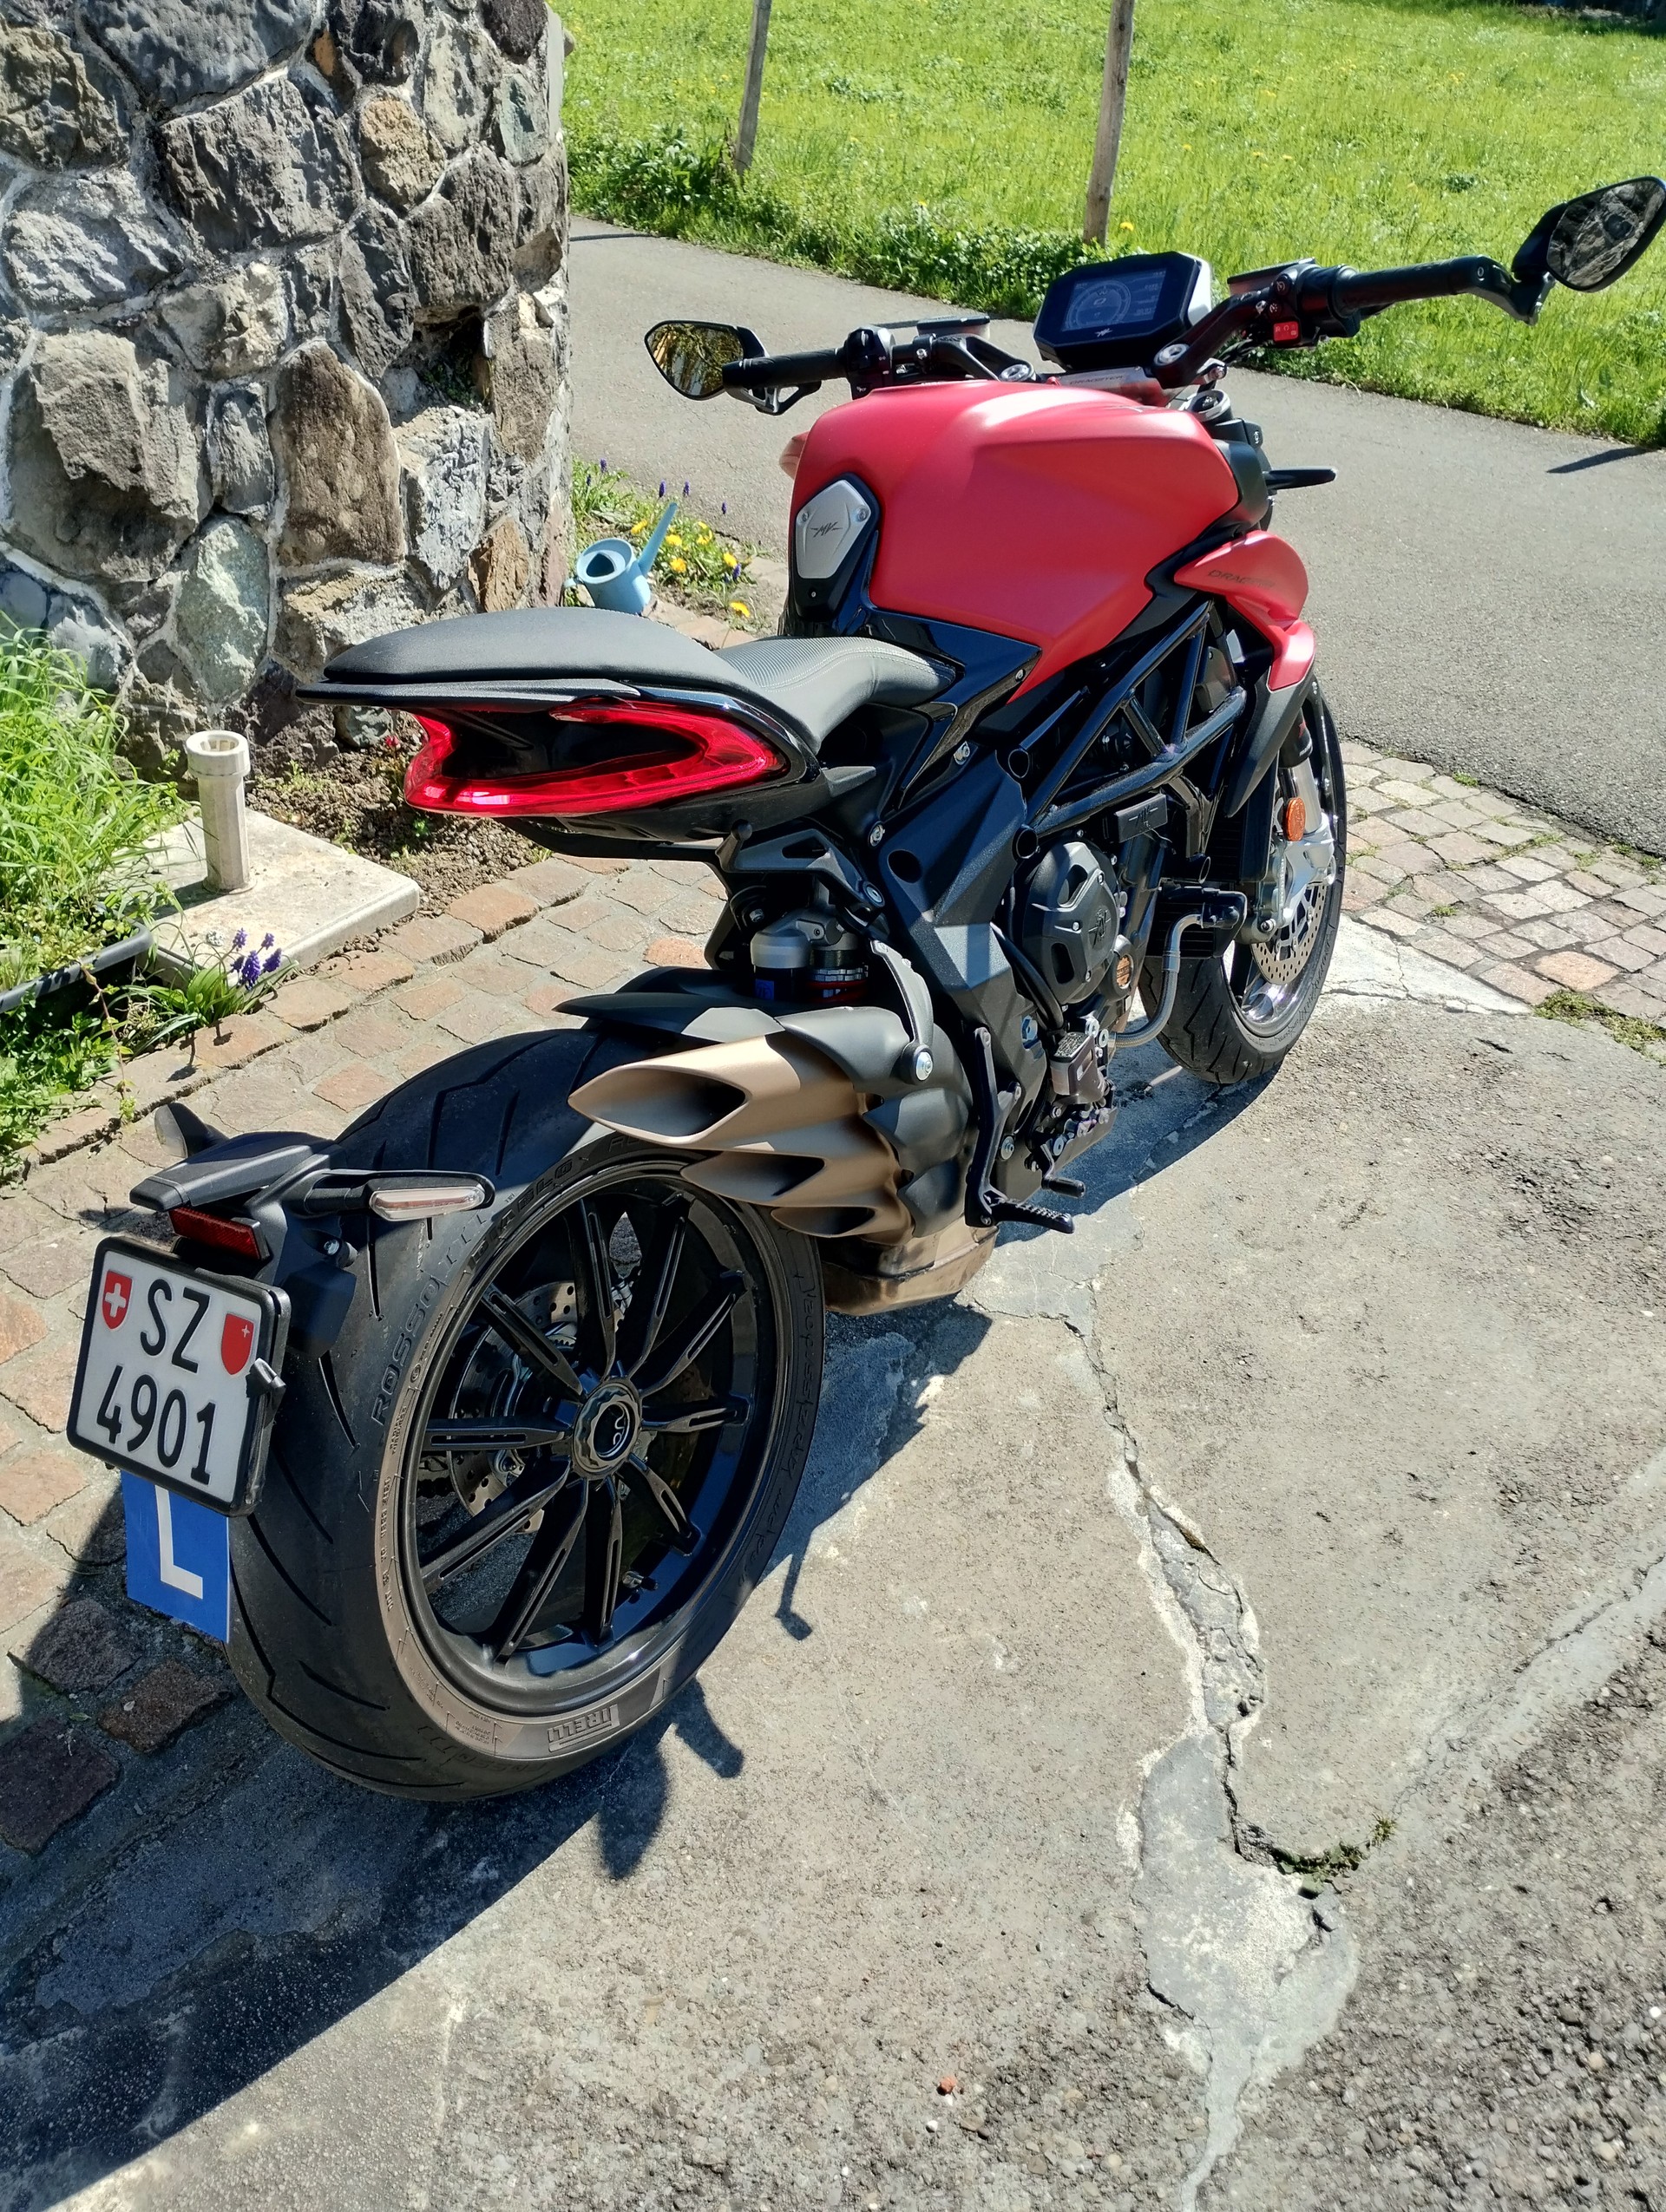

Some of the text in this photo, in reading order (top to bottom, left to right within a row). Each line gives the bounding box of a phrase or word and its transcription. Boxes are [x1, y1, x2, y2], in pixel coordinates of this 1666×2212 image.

[140, 1279, 211, 1374] SZ
[371, 1276, 441, 1427] ROSSO
[96, 1365, 216, 1486] 4901
[154, 1485, 204, 1600] L
[547, 1704, 620, 1753] PIRELLI
